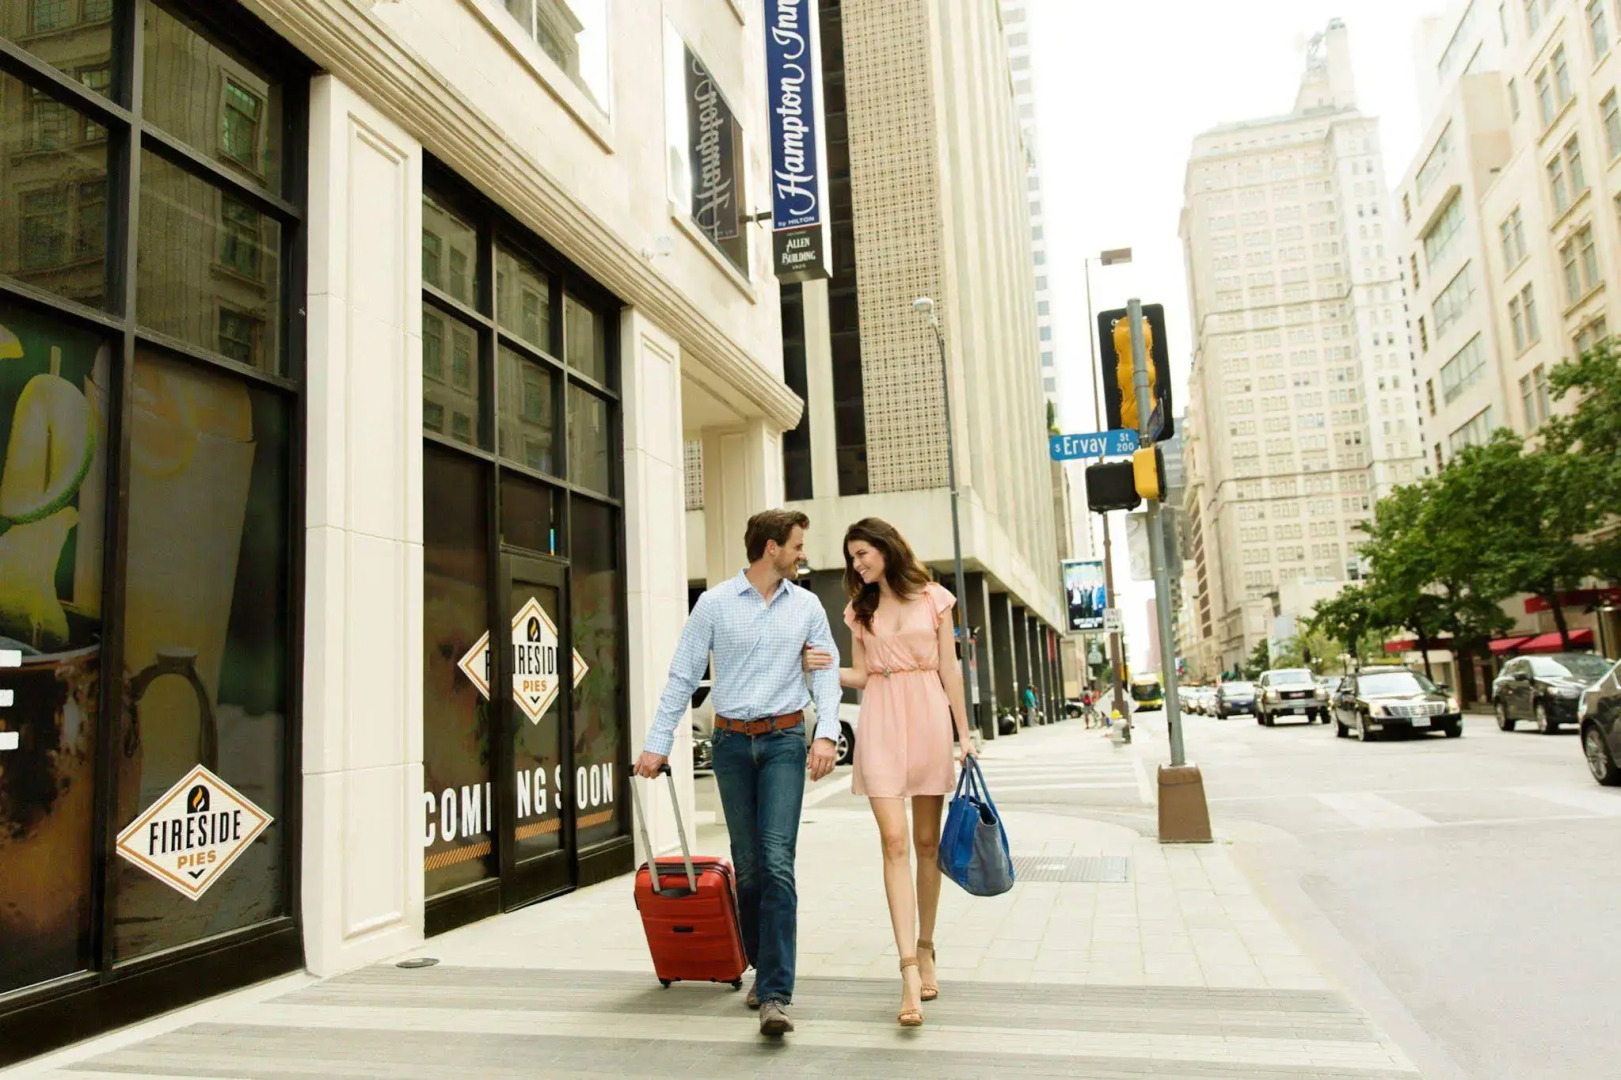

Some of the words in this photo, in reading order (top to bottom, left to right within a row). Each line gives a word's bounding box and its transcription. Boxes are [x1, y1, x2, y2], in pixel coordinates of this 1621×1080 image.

[772, 0, 805, 60] Inn
[775, 64, 816, 216] Hampton
[788, 216, 815, 225] HILTON
[786, 237, 810, 253] ALLEN
[782, 251, 816, 265] BUILDING
[1063, 437, 1107, 455] Ervay
[1120, 432, 1129, 441] St
[1116, 442, 1135, 452] 200
[522, 680, 547, 692] PIES
[424, 767, 547, 847] COMING
[149, 810, 241, 856] FIRESIDE
[177, 850, 216, 869] PIES
